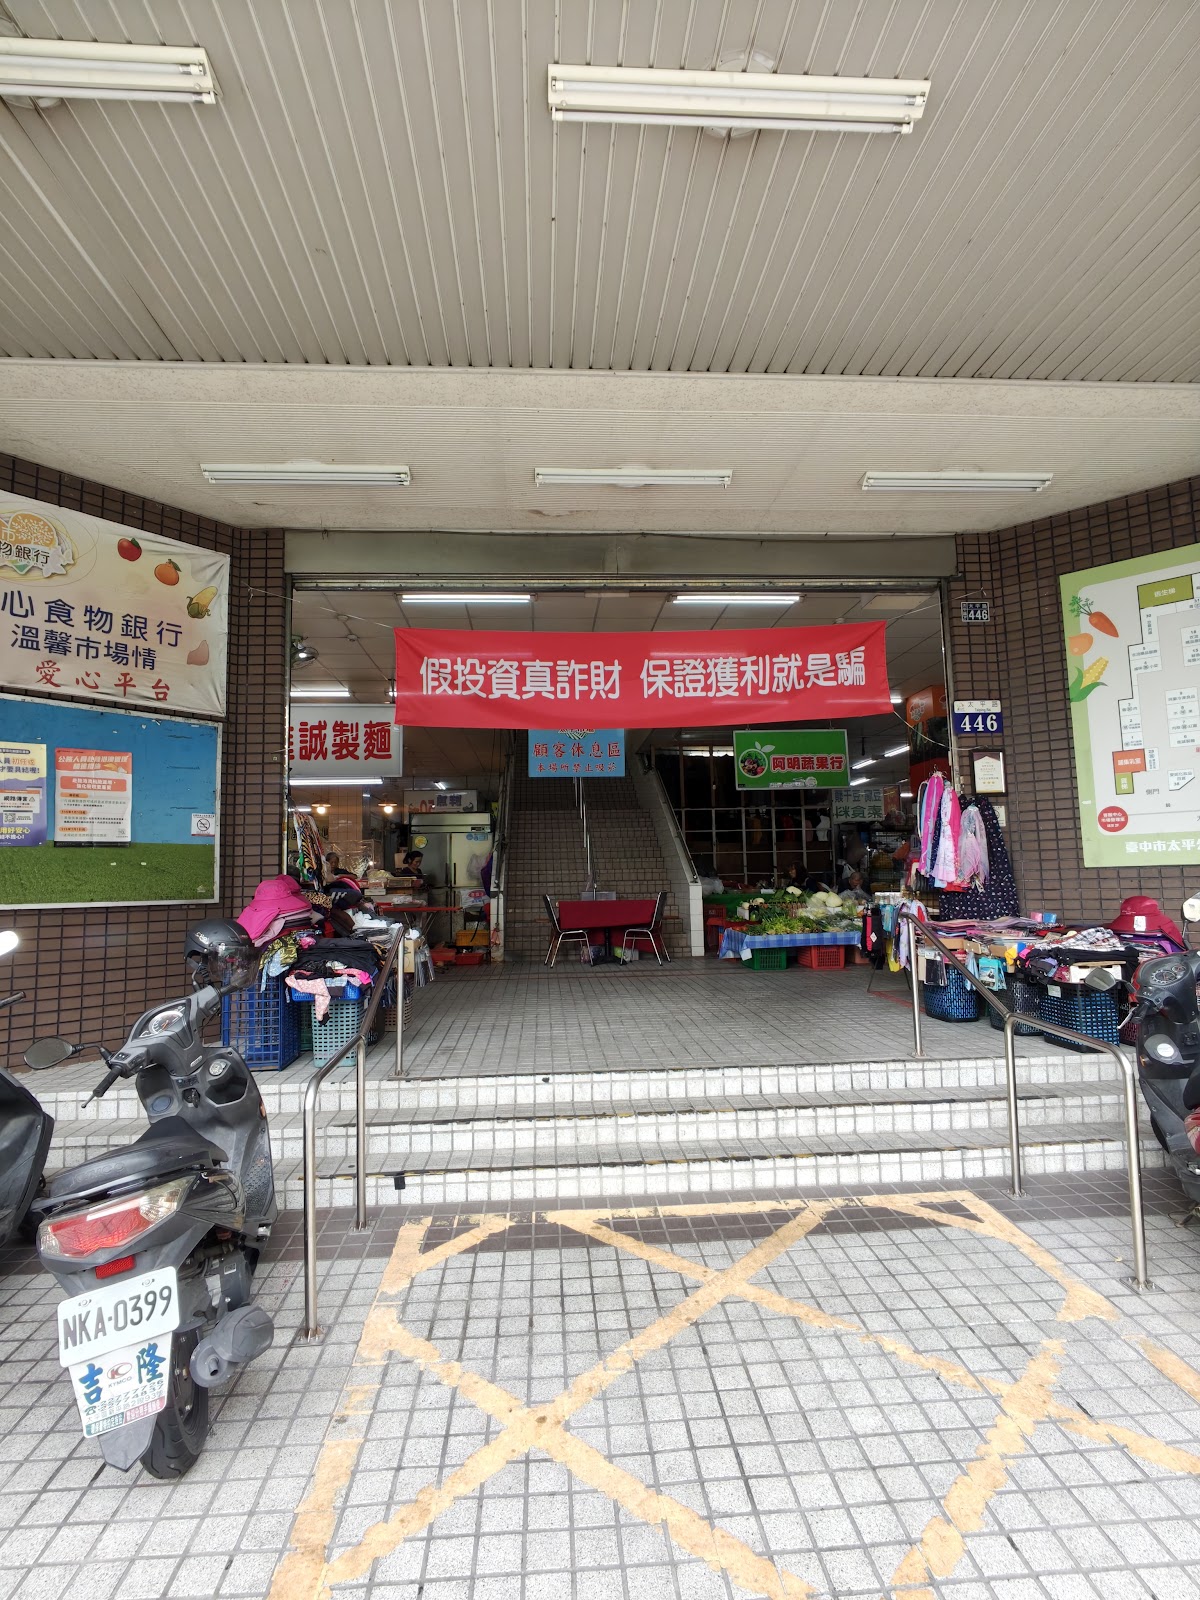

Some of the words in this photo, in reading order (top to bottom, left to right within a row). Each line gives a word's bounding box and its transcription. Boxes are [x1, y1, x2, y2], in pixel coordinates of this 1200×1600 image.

[969, 609, 988, 620] 446
[10, 622, 157, 670] 溫馨市場情
[35, 660, 171, 702] 愛心平台
[420, 656, 622, 700] 假投資真詐財
[640, 646, 866, 699] 保證獲利就是騙
[961, 714, 998, 732] 446
[533, 742, 620, 758] 顧客休息區
[537, 762, 617, 773] 本場所禁止吸菸
[771, 755, 845, 772] 阿明蔬果行
[63, 1285, 173, 1350] NKA-0399
[108, 1376, 133, 1388] KYMCO
